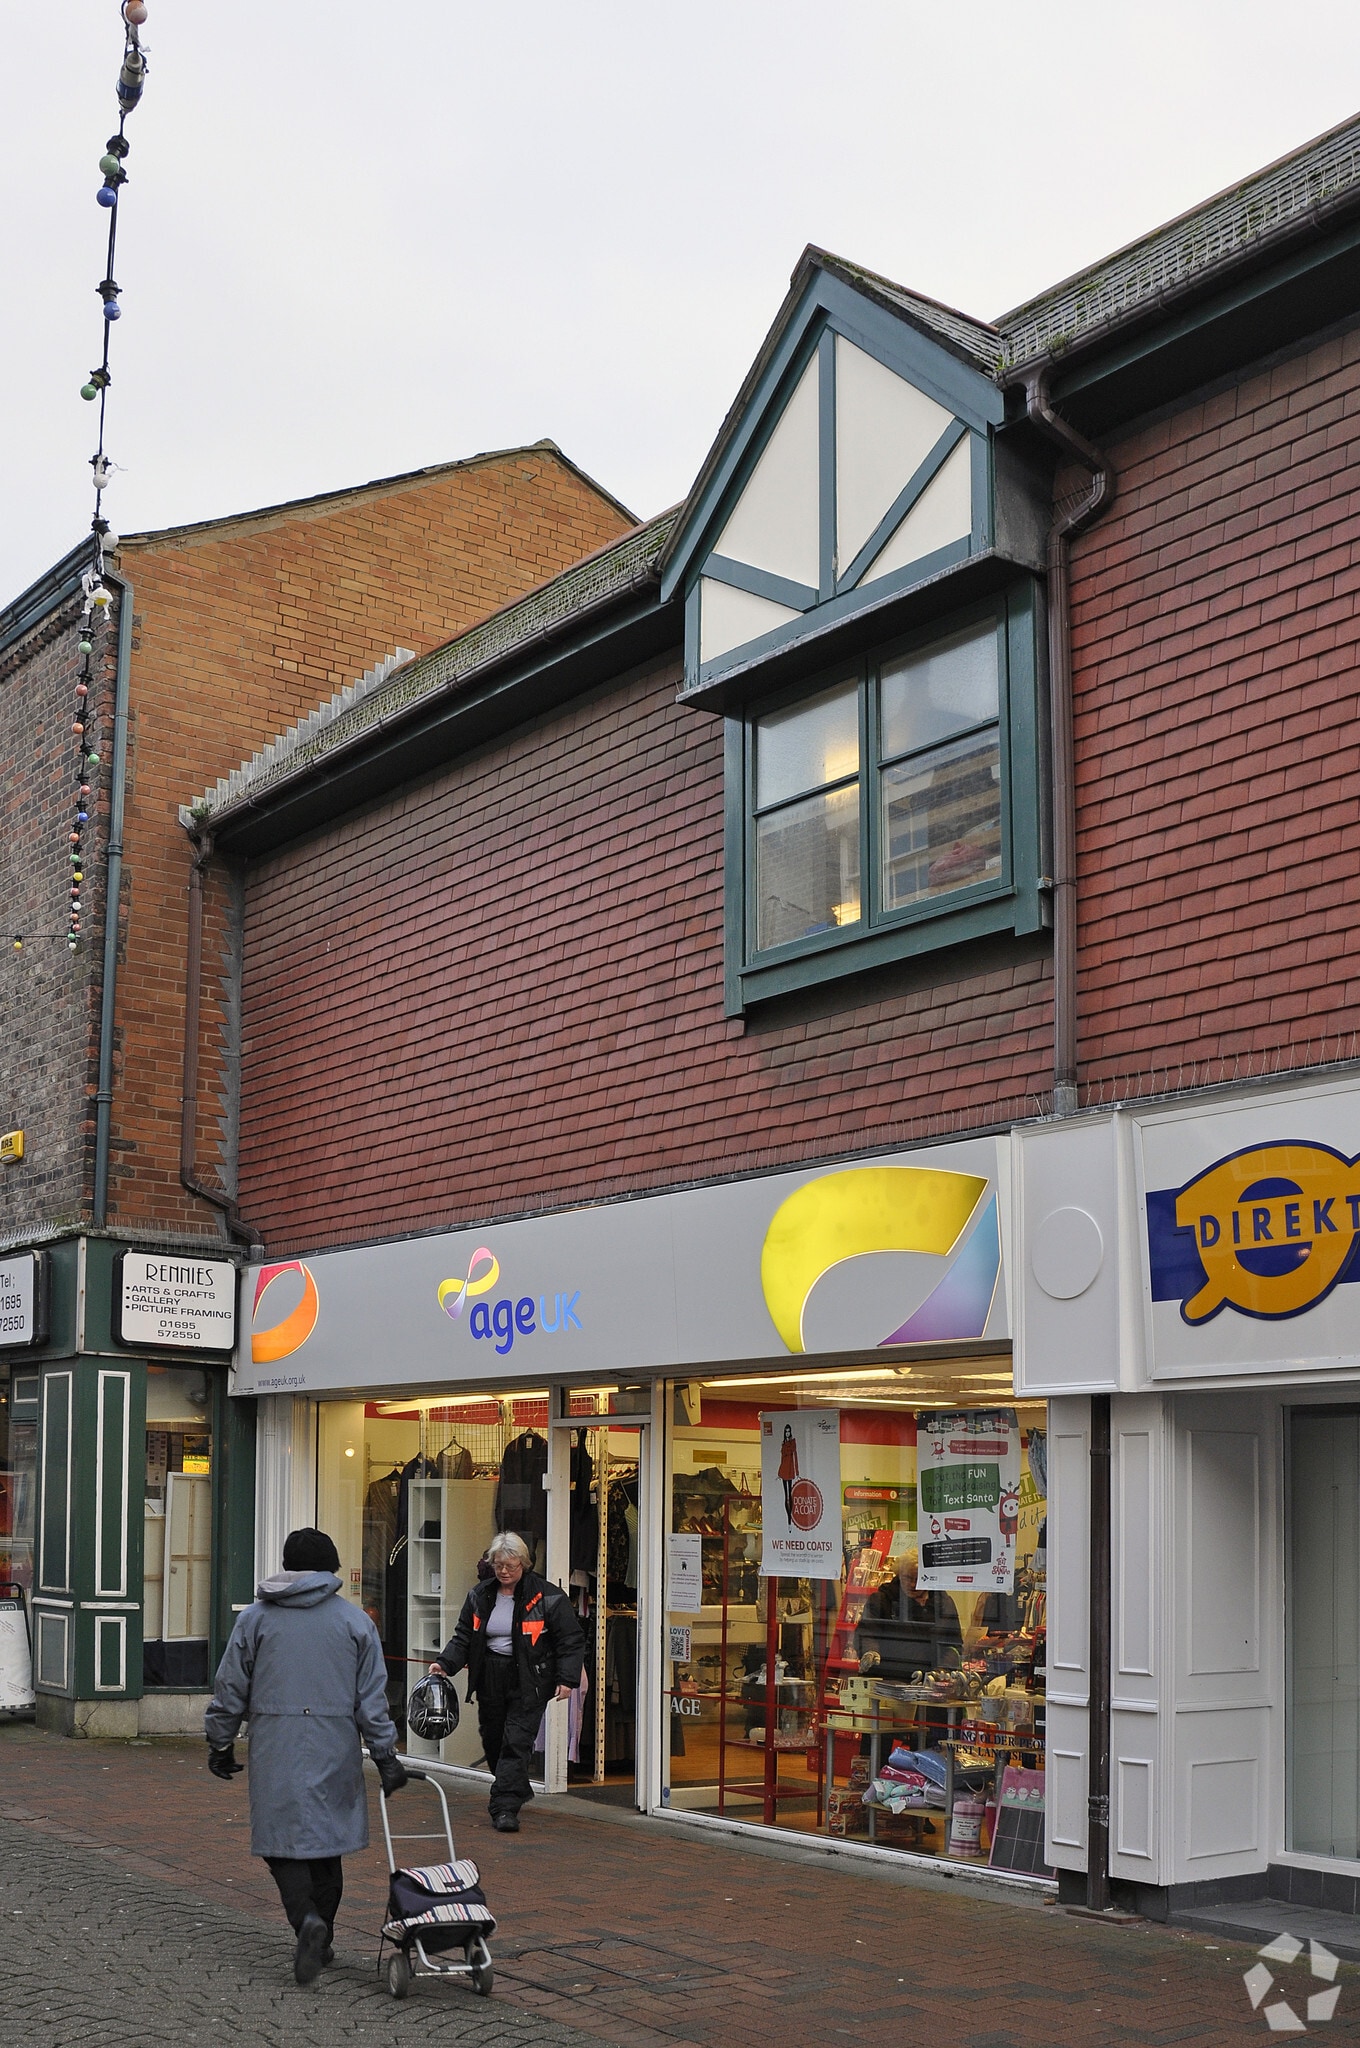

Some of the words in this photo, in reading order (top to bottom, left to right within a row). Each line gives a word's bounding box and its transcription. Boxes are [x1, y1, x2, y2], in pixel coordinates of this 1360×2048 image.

[1200, 1194, 1360, 1248] DIREKT
[146, 1263, 214, 1287] RENNIES
[131, 1285, 160, 1295] ARTS
[163, 1288, 171, 1296] &
[174, 1289, 216, 1300] CRAFTS
[1, 1294, 22, 1311] 1695
[131, 1294, 181, 1305] GALLERY
[131, 1303, 178, 1315] PICTURE
[180, 1307, 232, 1319] FRAMING
[0, 1315, 25, 1332] 72550
[159, 1319, 196, 1330] 01695
[157, 1329, 201, 1340] 572550
[257, 1374, 306, 1388] www.ageuk.org.uk
[968, 1468, 987, 1479] FUN
[853, 1490, 882, 1498] information
[943, 1494, 964, 1505] Text
[966, 1493, 994, 1504] Santa
[793, 1496, 817, 1506] DONATE
[794, 1505, 799, 1515] A
[800, 1505, 816, 1515] COAT
[771, 1540, 784, 1550] WE
[785, 1540, 805, 1551] NEED
[806, 1541, 833, 1552] COATS!
[670, 1627, 686, 1636] LOVE
[671, 1696, 701, 1716] AGE
